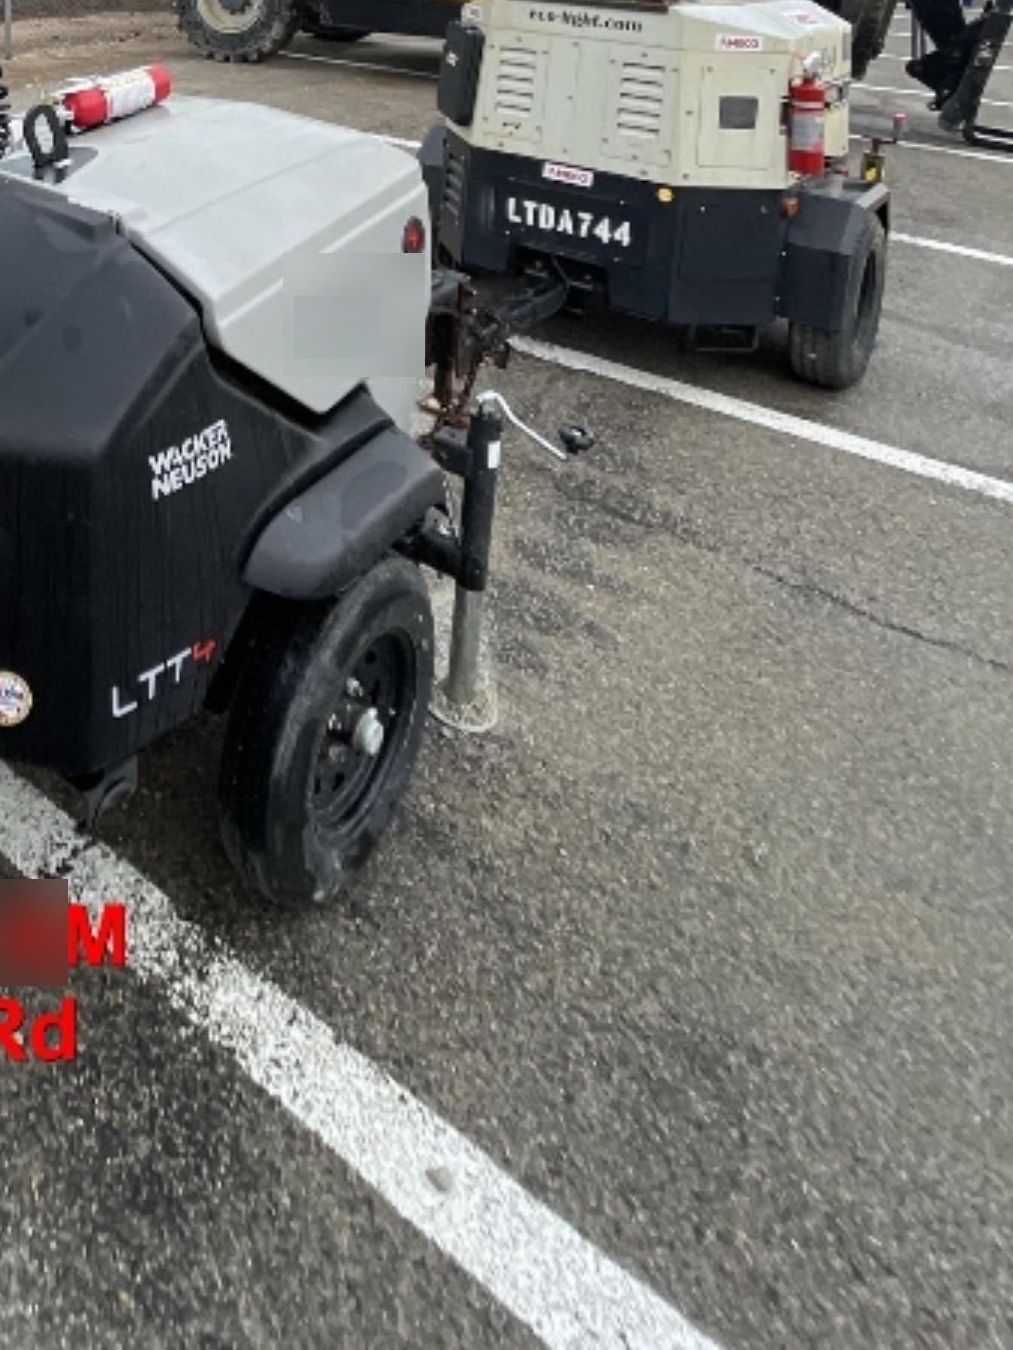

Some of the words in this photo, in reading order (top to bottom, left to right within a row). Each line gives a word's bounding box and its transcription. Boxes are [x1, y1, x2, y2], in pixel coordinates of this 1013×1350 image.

[529, 10, 643, 32] eco-light.com
[507, 197, 631, 247] LTDA744
[148, 418, 228, 476] WACKER
[151, 436, 232, 500] NEUSON
